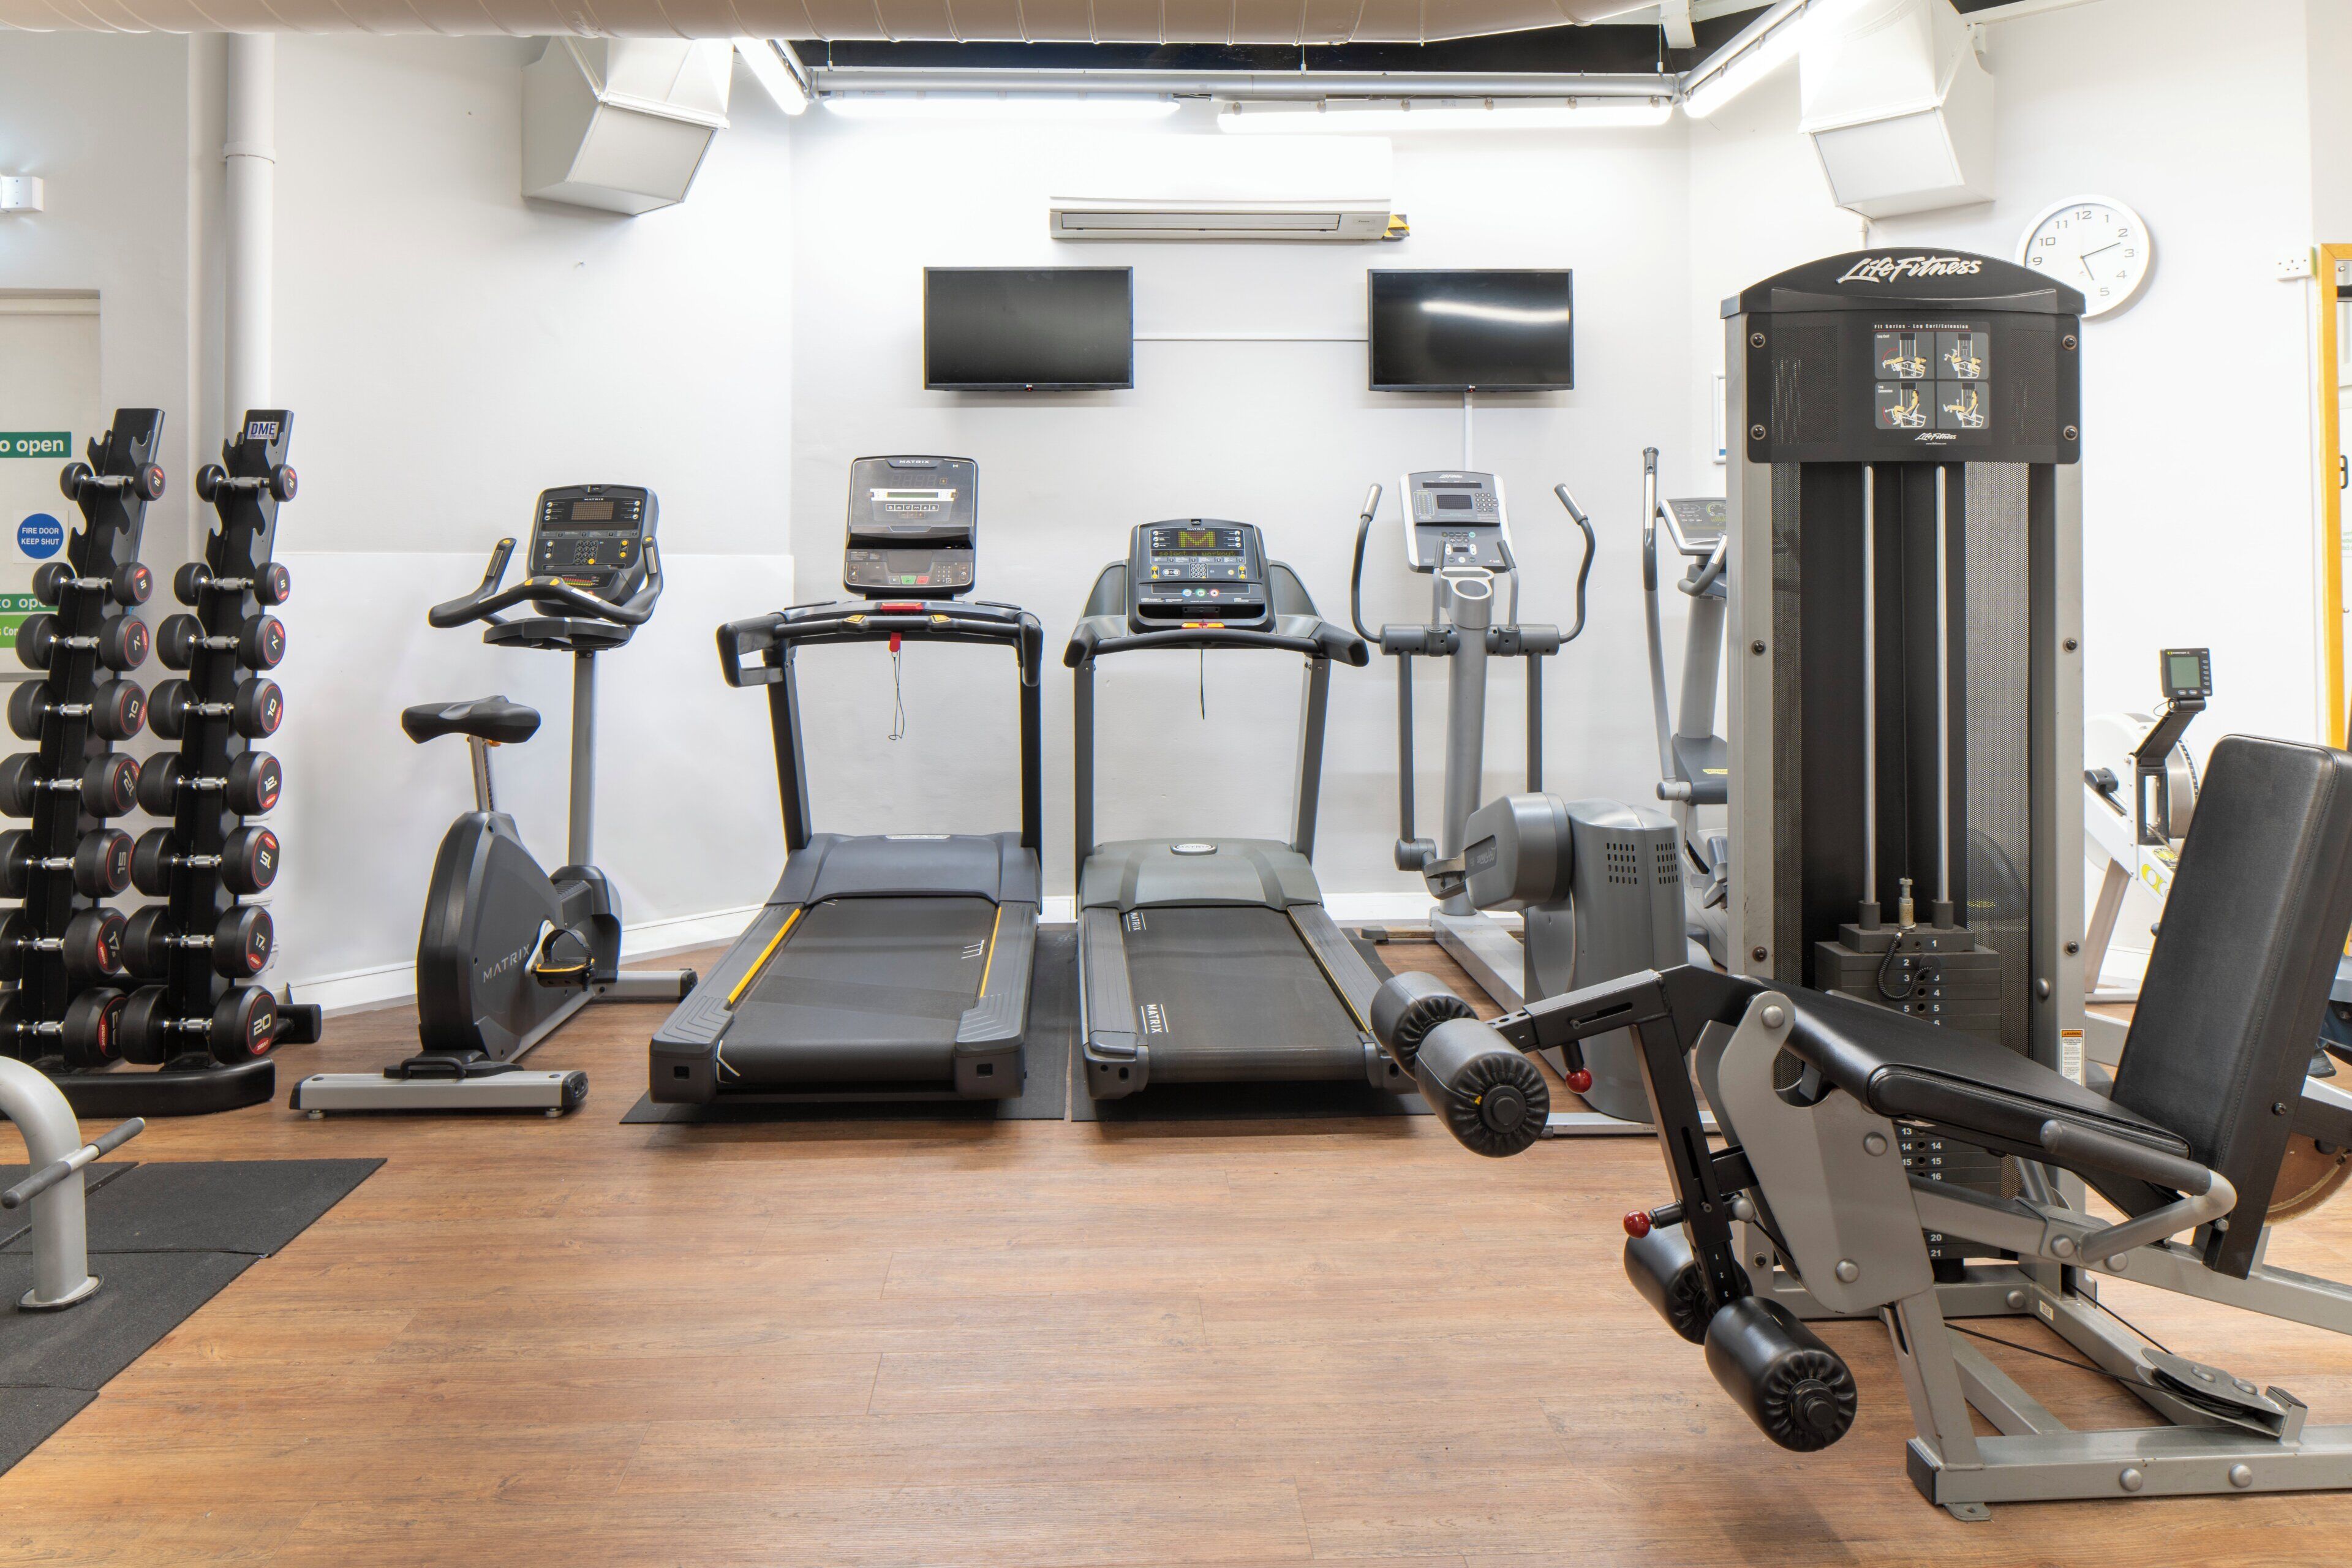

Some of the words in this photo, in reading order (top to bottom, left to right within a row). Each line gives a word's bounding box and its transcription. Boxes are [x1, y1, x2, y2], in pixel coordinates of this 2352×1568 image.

[2075, 211, 2092, 221] 12
[2055, 220, 2068, 229] 11
[2117, 228, 2128, 238] 2
[2039, 236, 2056, 246] 10
[2124, 249, 2135, 258] 3
[2032, 257, 2043, 265] 9
[2116, 270, 2127, 279] 4
[2100, 287, 2110, 296] 5
[251, 423, 276, 435] DME
[17, 440, 64, 456] open
[154, 476, 160, 486] 2
[288, 478, 294, 488] 2
[140, 579, 146, 589] 5
[280, 579, 286, 588] 5
[0, 598, 11, 608] o
[129, 700, 139, 718] 10
[267, 698, 277, 717] 10
[117, 852, 127, 875] 15
[260, 850, 271, 869] 15
[1130, 912, 1141, 931] MATRIX
[483, 943, 530, 983] MATRIX
[1147, 1004, 1163, 1033] MATRIX
[254, 1013, 271, 1036] 20
